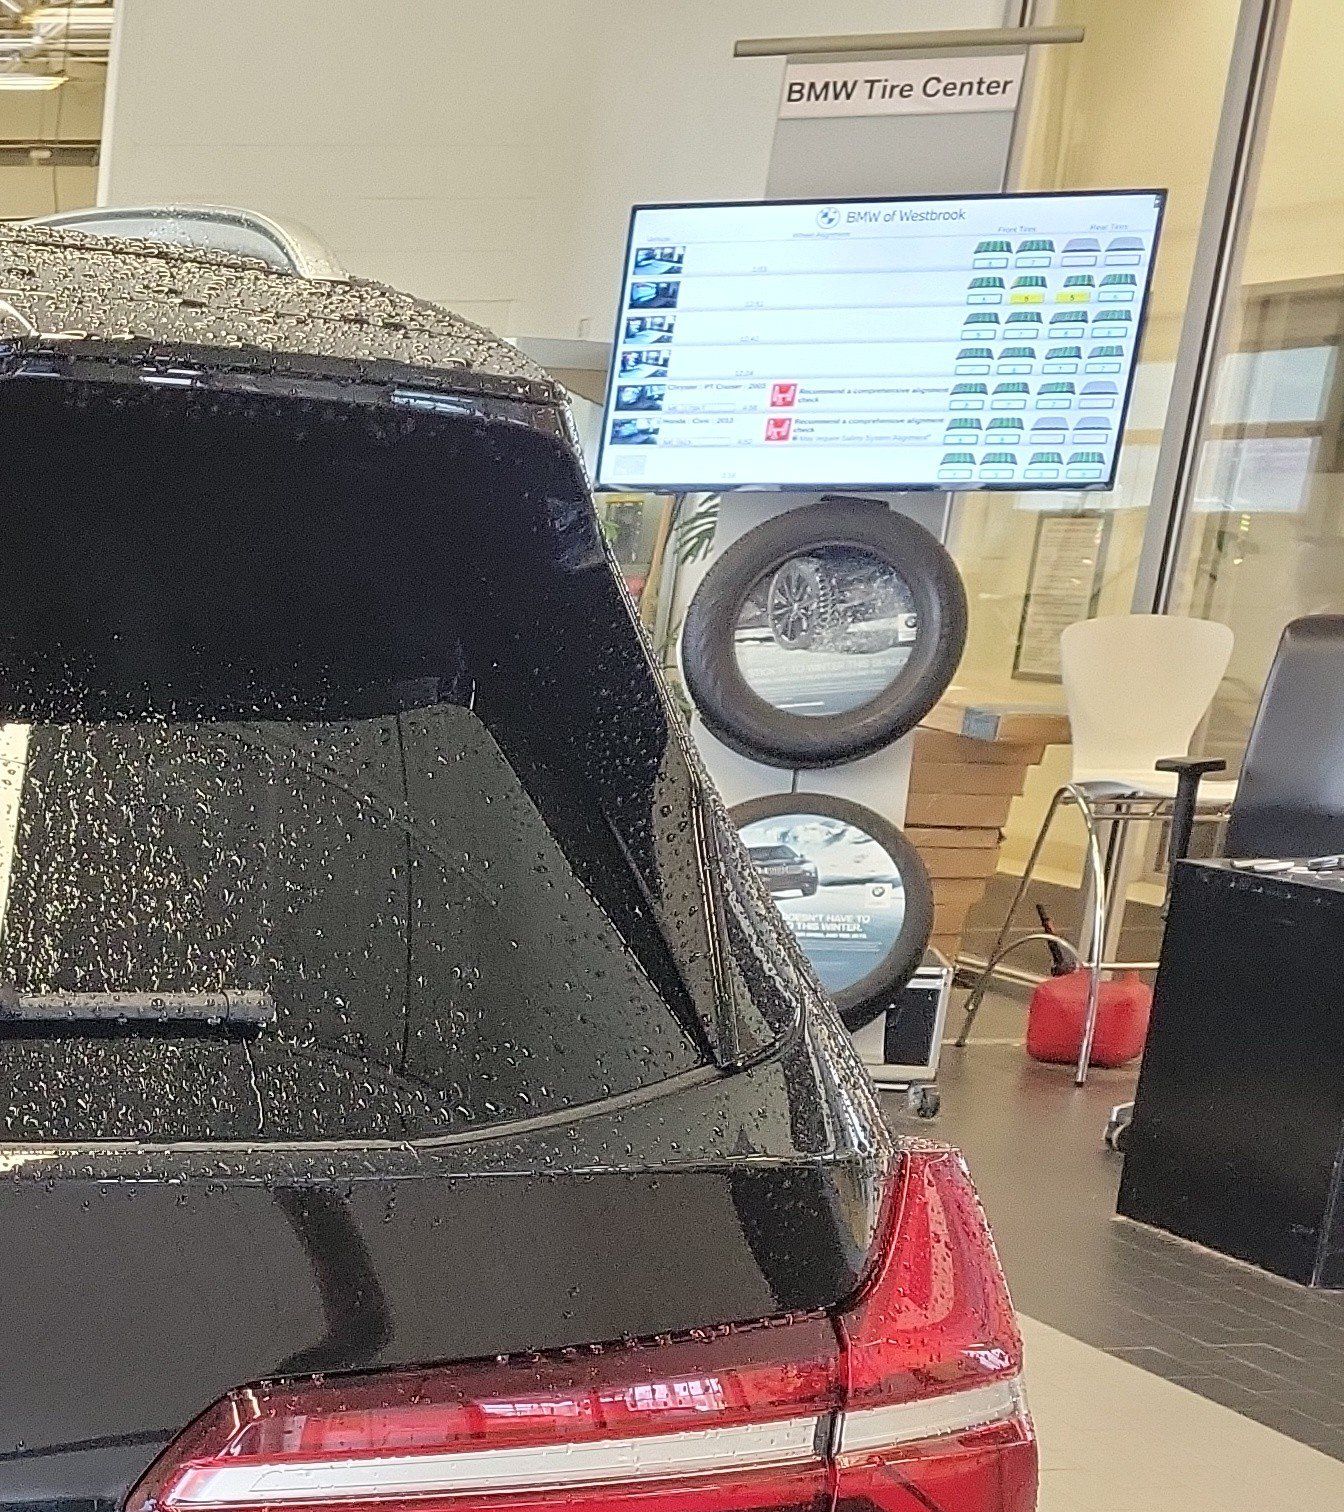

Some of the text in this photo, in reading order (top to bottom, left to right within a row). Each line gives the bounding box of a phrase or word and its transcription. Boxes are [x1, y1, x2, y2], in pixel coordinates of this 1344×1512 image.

[787, 76, 1013, 102] BMW Tire Center
[846, 208, 967, 223] BMW of Westbrook
